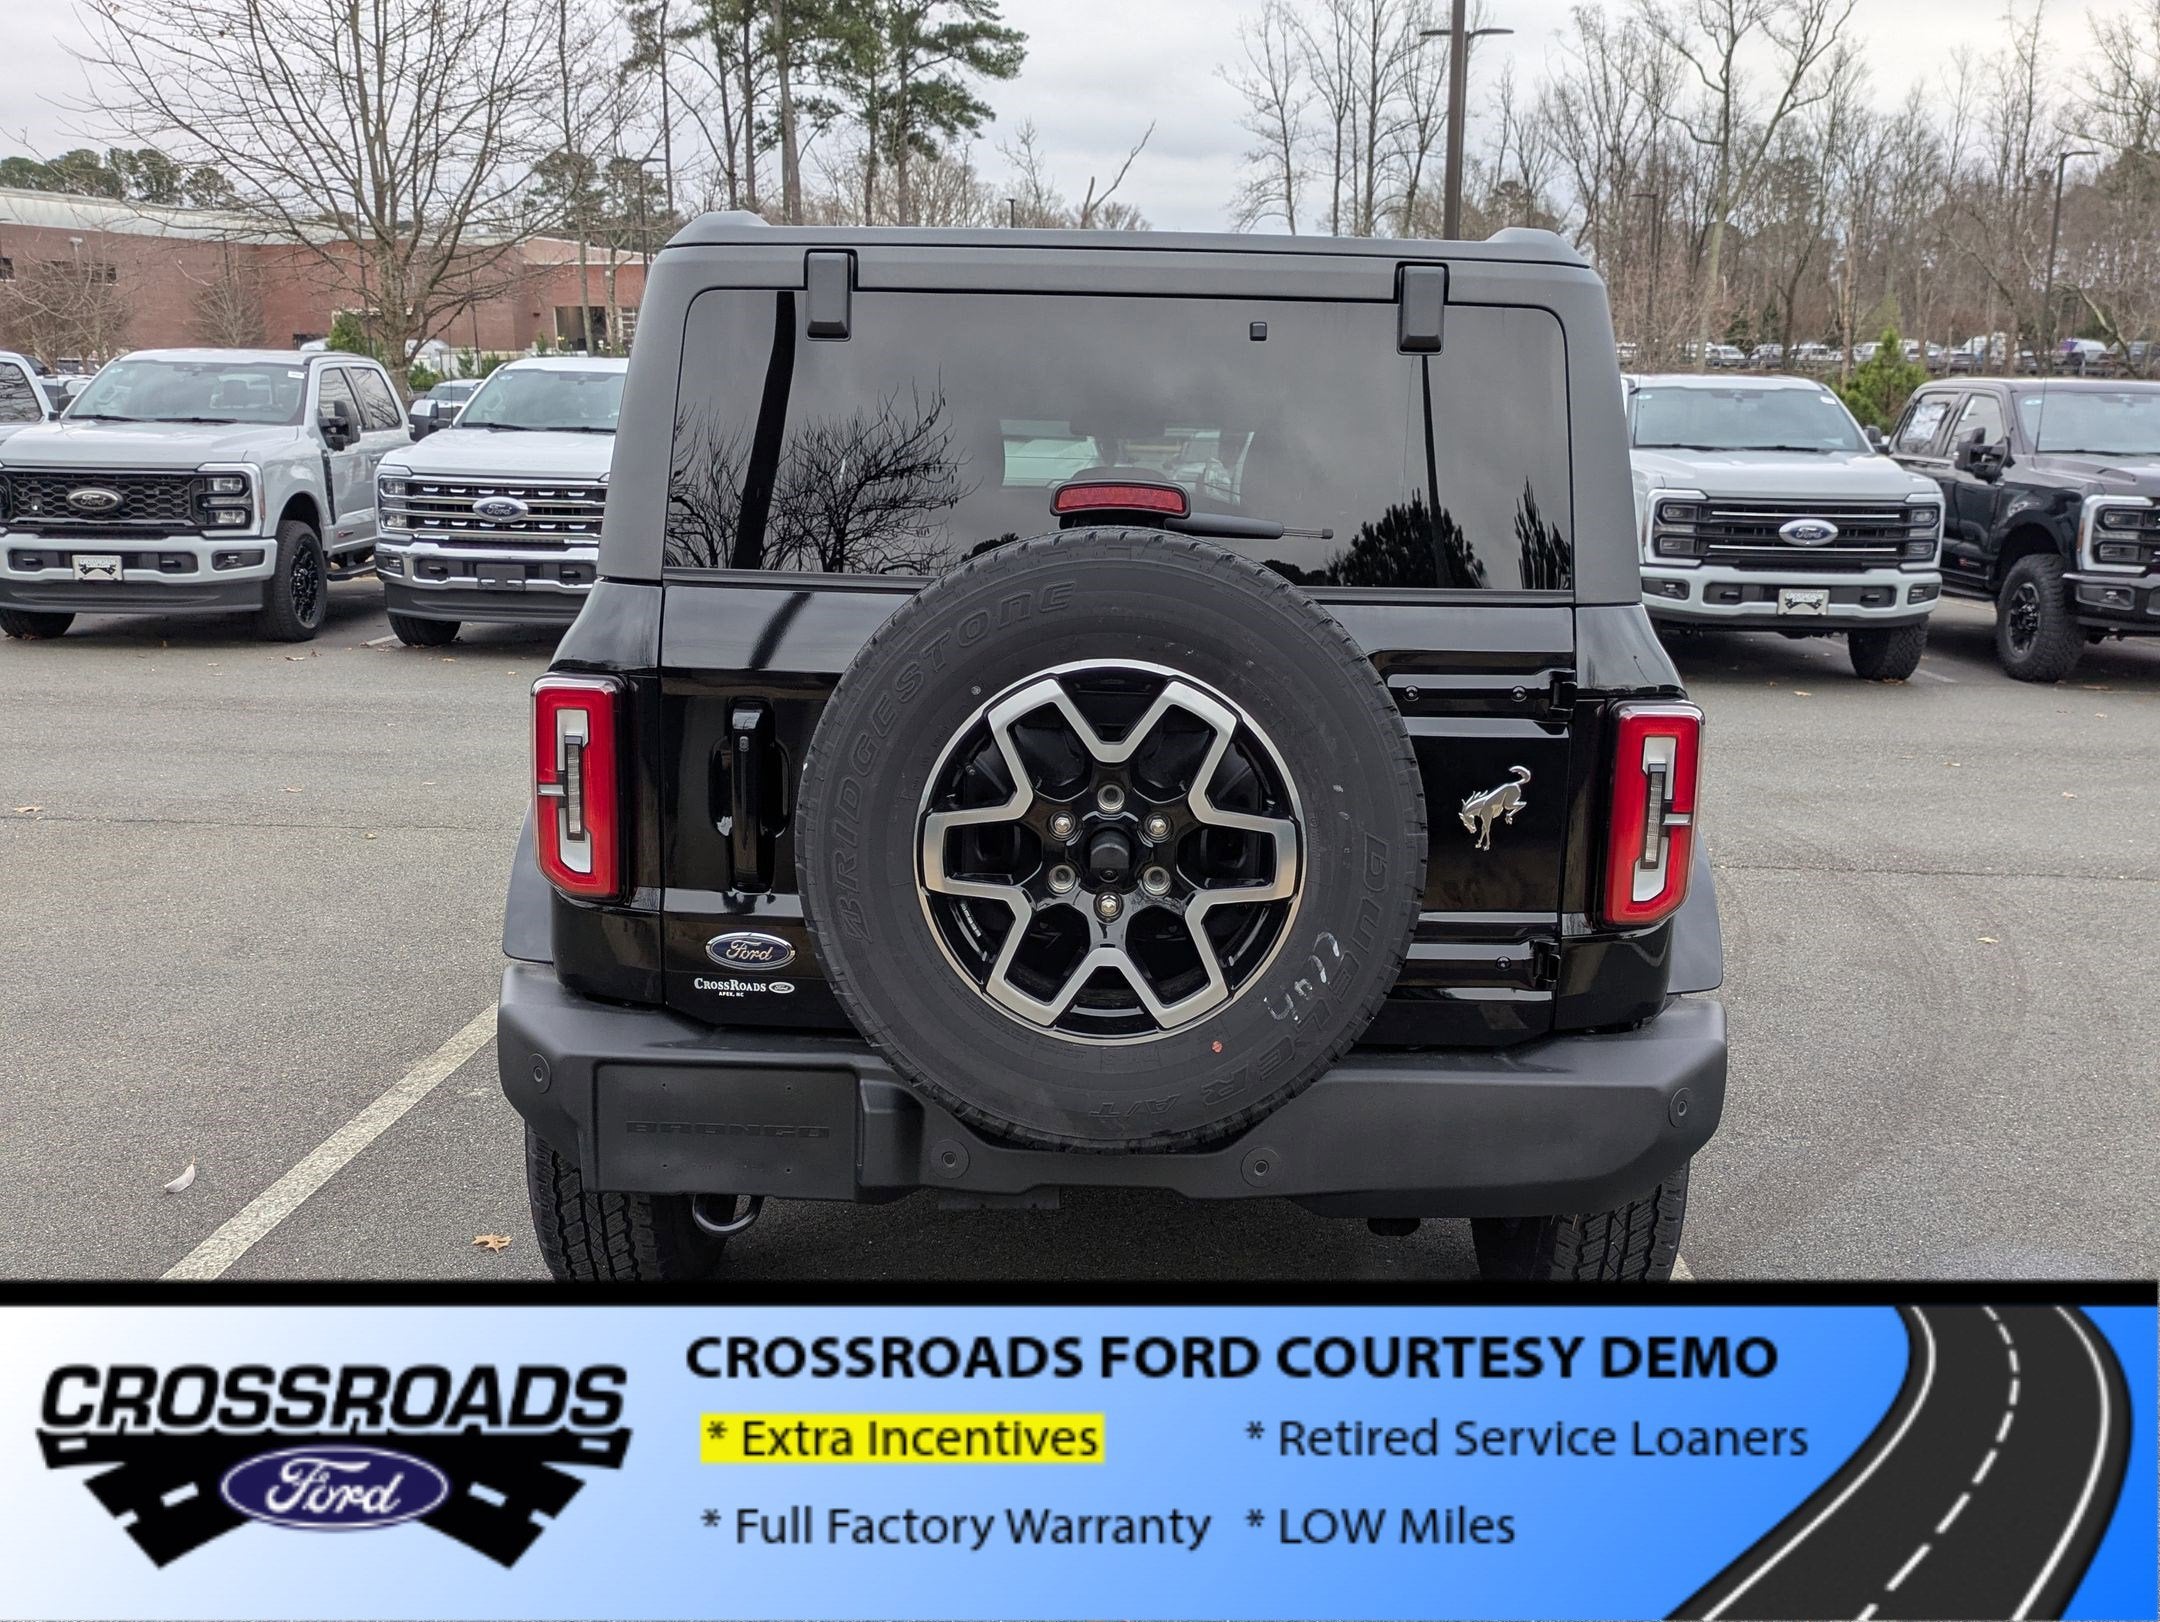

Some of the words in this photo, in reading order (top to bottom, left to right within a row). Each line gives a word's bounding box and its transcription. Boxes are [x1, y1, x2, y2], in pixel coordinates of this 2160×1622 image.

[831, 579, 1078, 944] BRIDGESTONE
[1201, 832, 1391, 1107] DUELER
[626, 1120, 830, 1139] BRONCO
